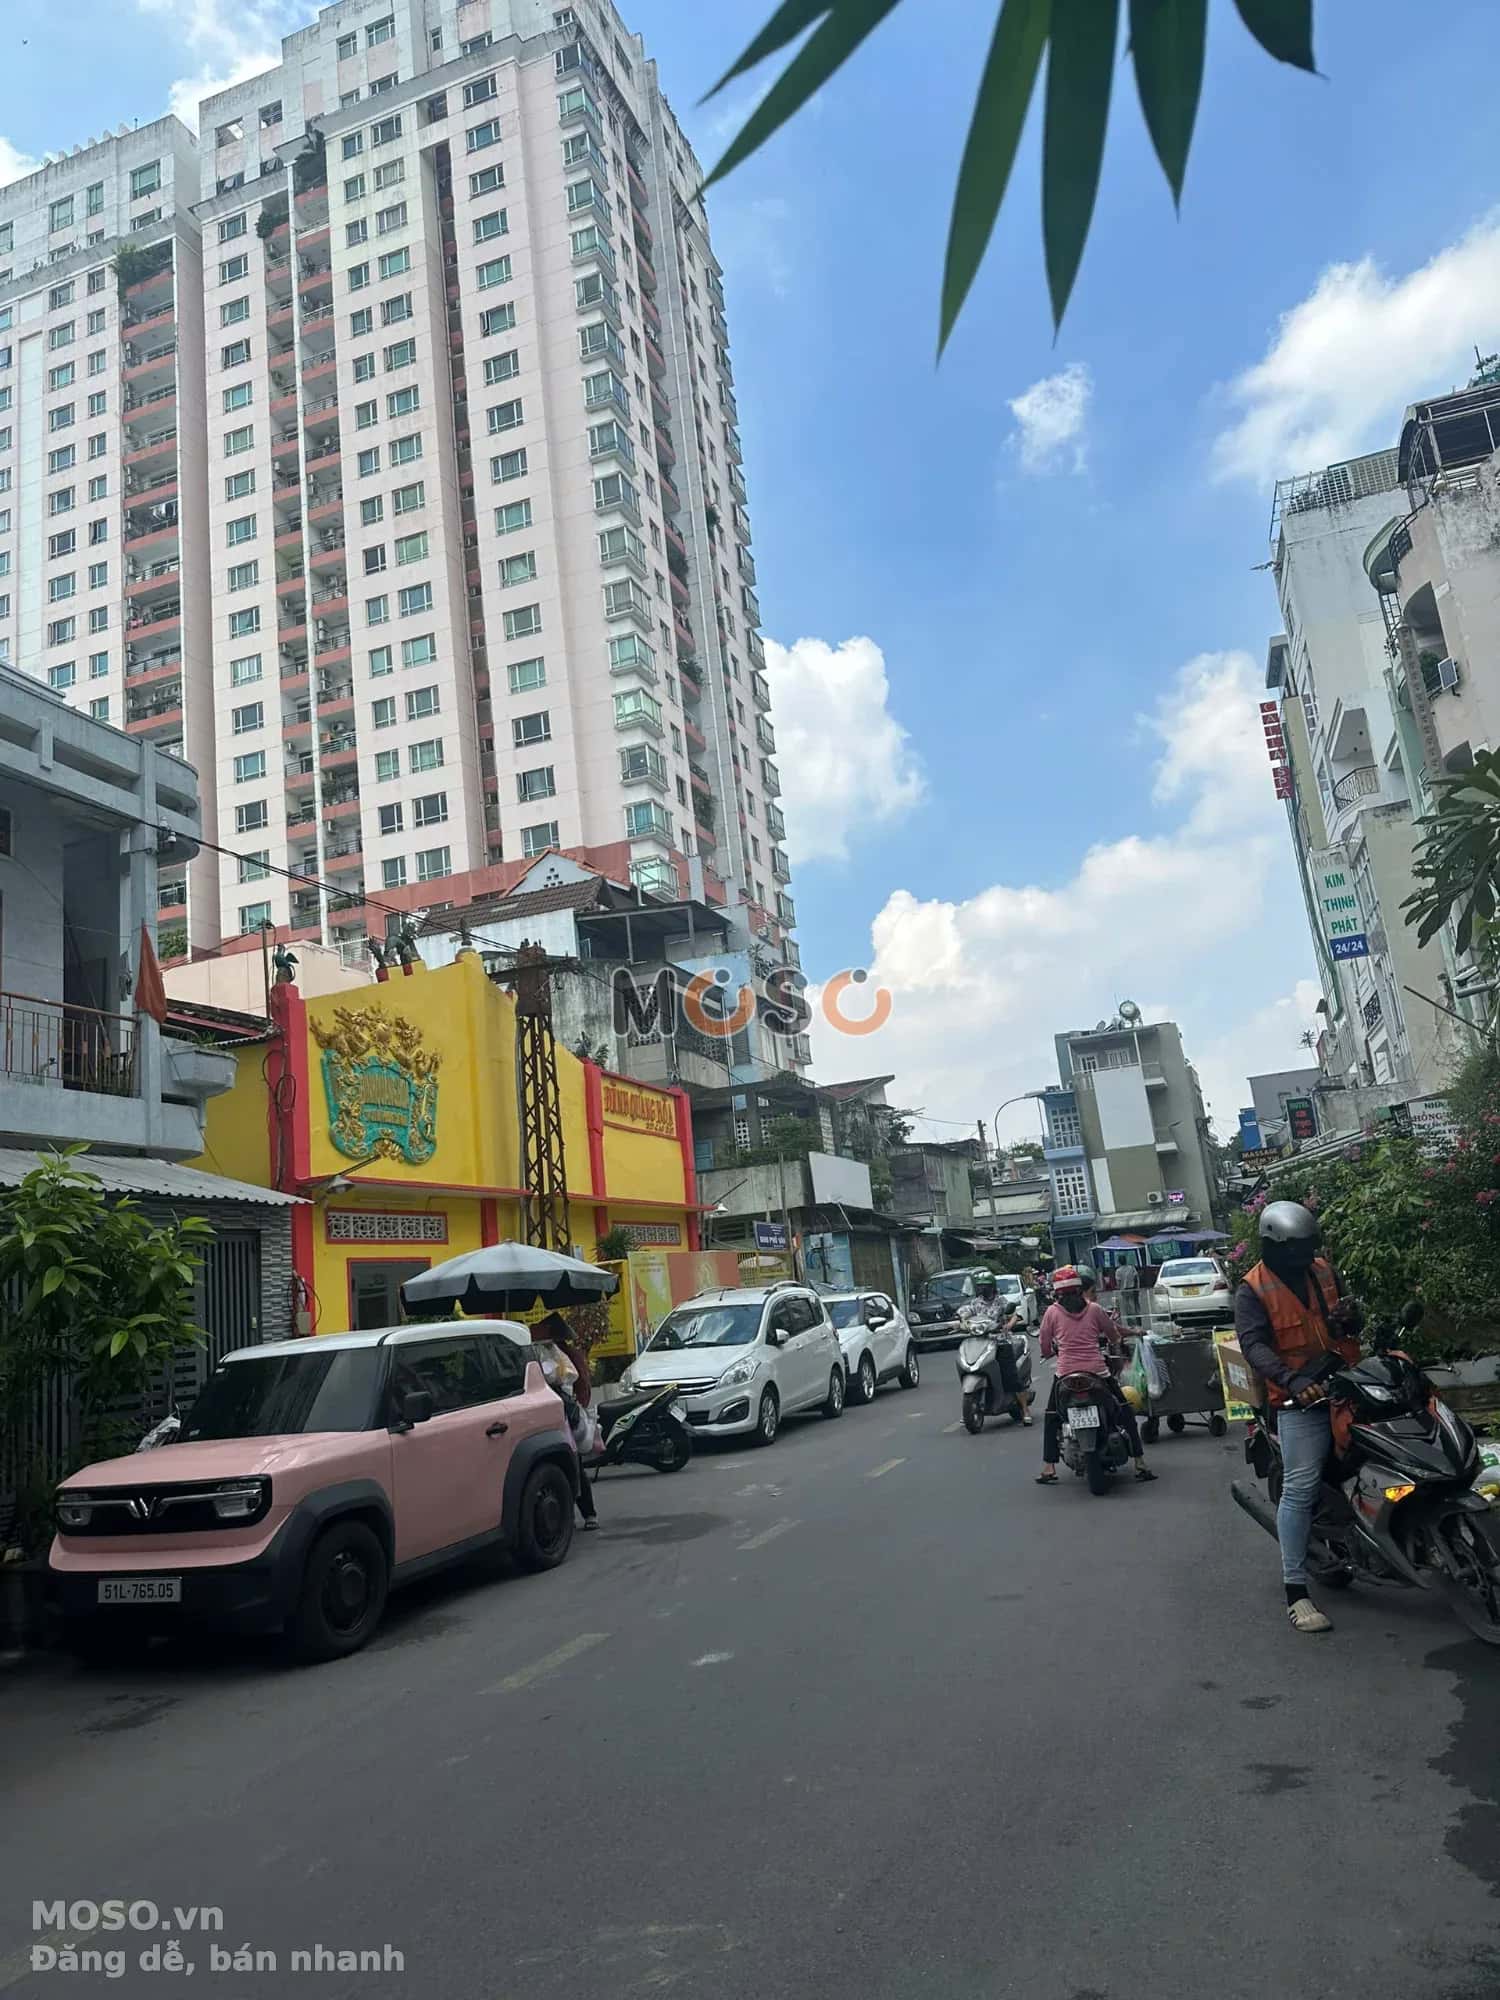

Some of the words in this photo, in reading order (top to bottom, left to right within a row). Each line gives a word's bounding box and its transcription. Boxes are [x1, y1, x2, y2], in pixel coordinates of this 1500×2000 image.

[1278, 767, 1291, 797] SPA
[1325, 873, 1345, 888] KIM
[1323, 895, 1356, 912] THỊNH
[1331, 915, 1358, 934] PHÁT
[1336, 942, 1363, 954] 24/24
[104, 1583, 173, 1599] 51L-765.05
